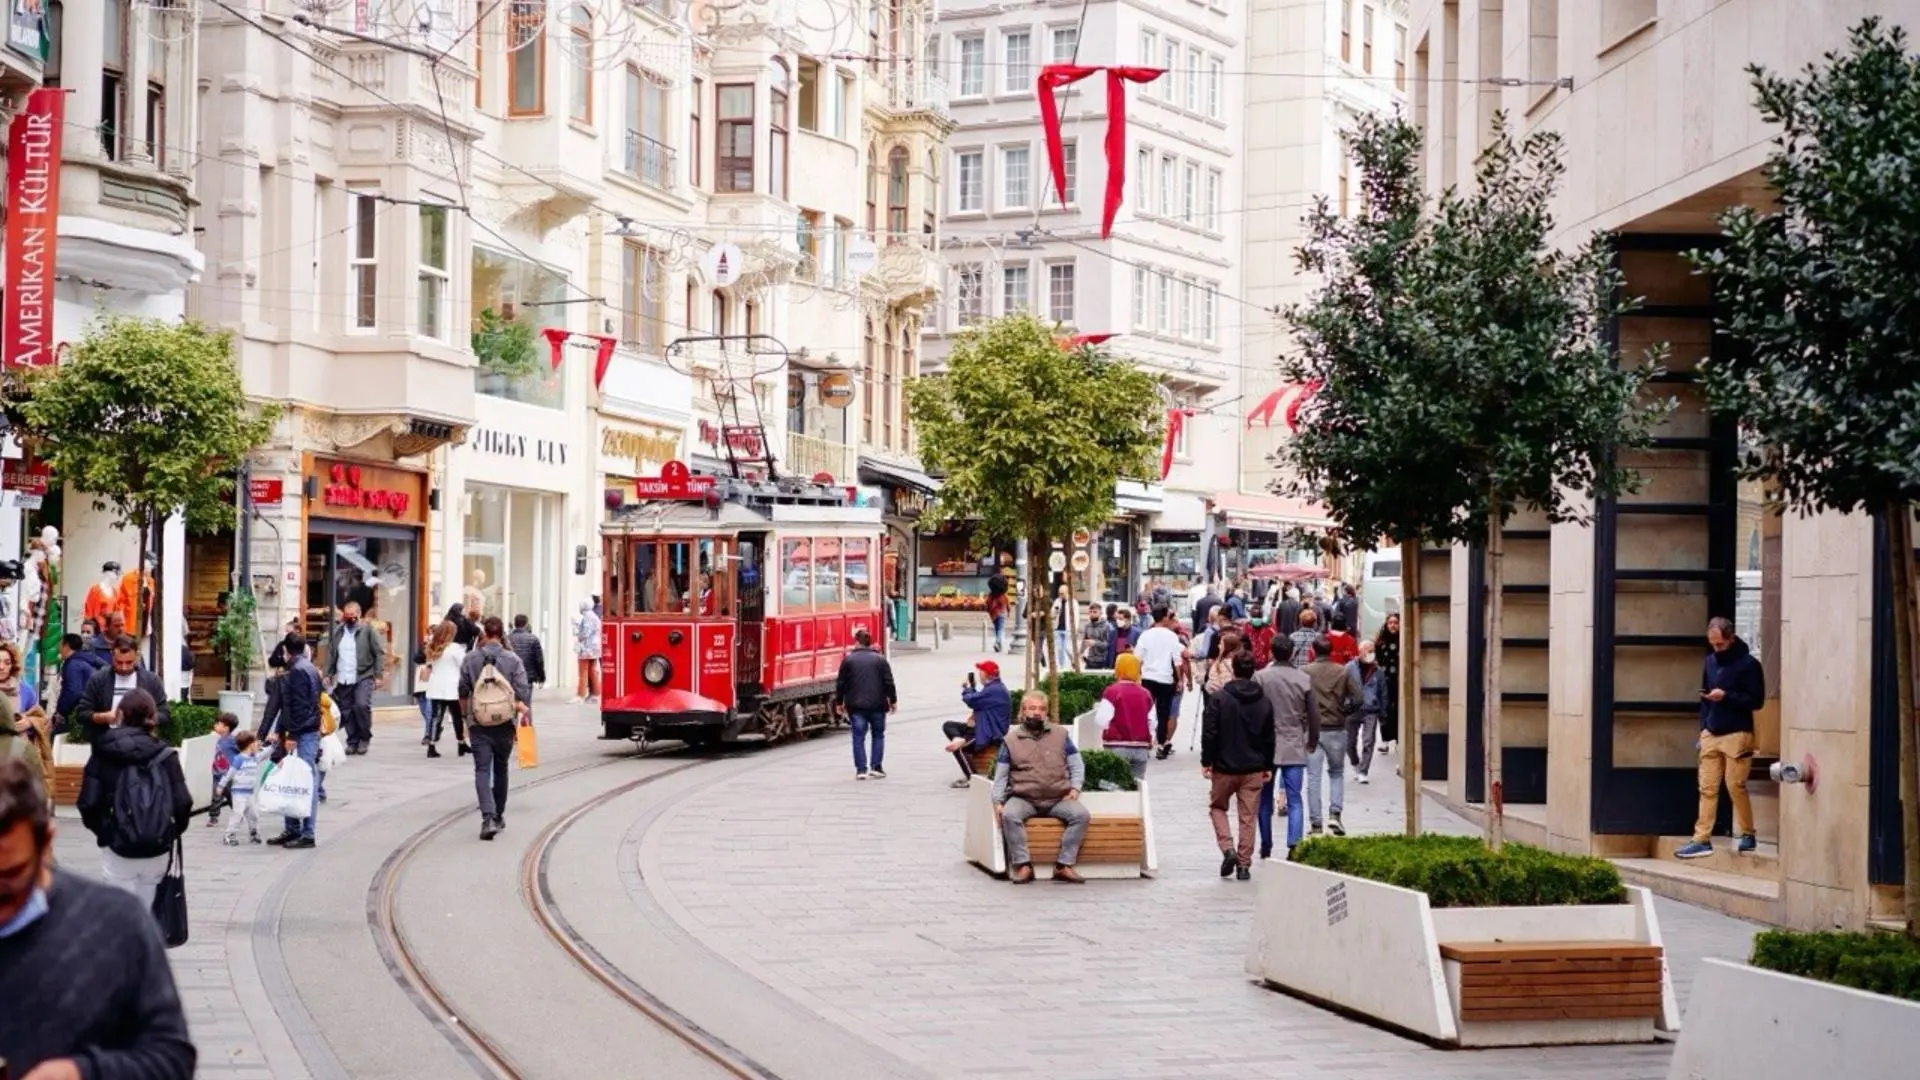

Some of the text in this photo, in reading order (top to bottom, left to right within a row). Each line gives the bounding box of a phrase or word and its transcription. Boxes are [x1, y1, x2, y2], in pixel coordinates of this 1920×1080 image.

[15, 112, 53, 369] AMERİKAN KÜLTÜR
[671, 462, 678, 476] 2
[4, 472, 46, 486] BERBER
[638, 479, 669, 493] TAKSİM
[264, 783, 278, 793] LC
